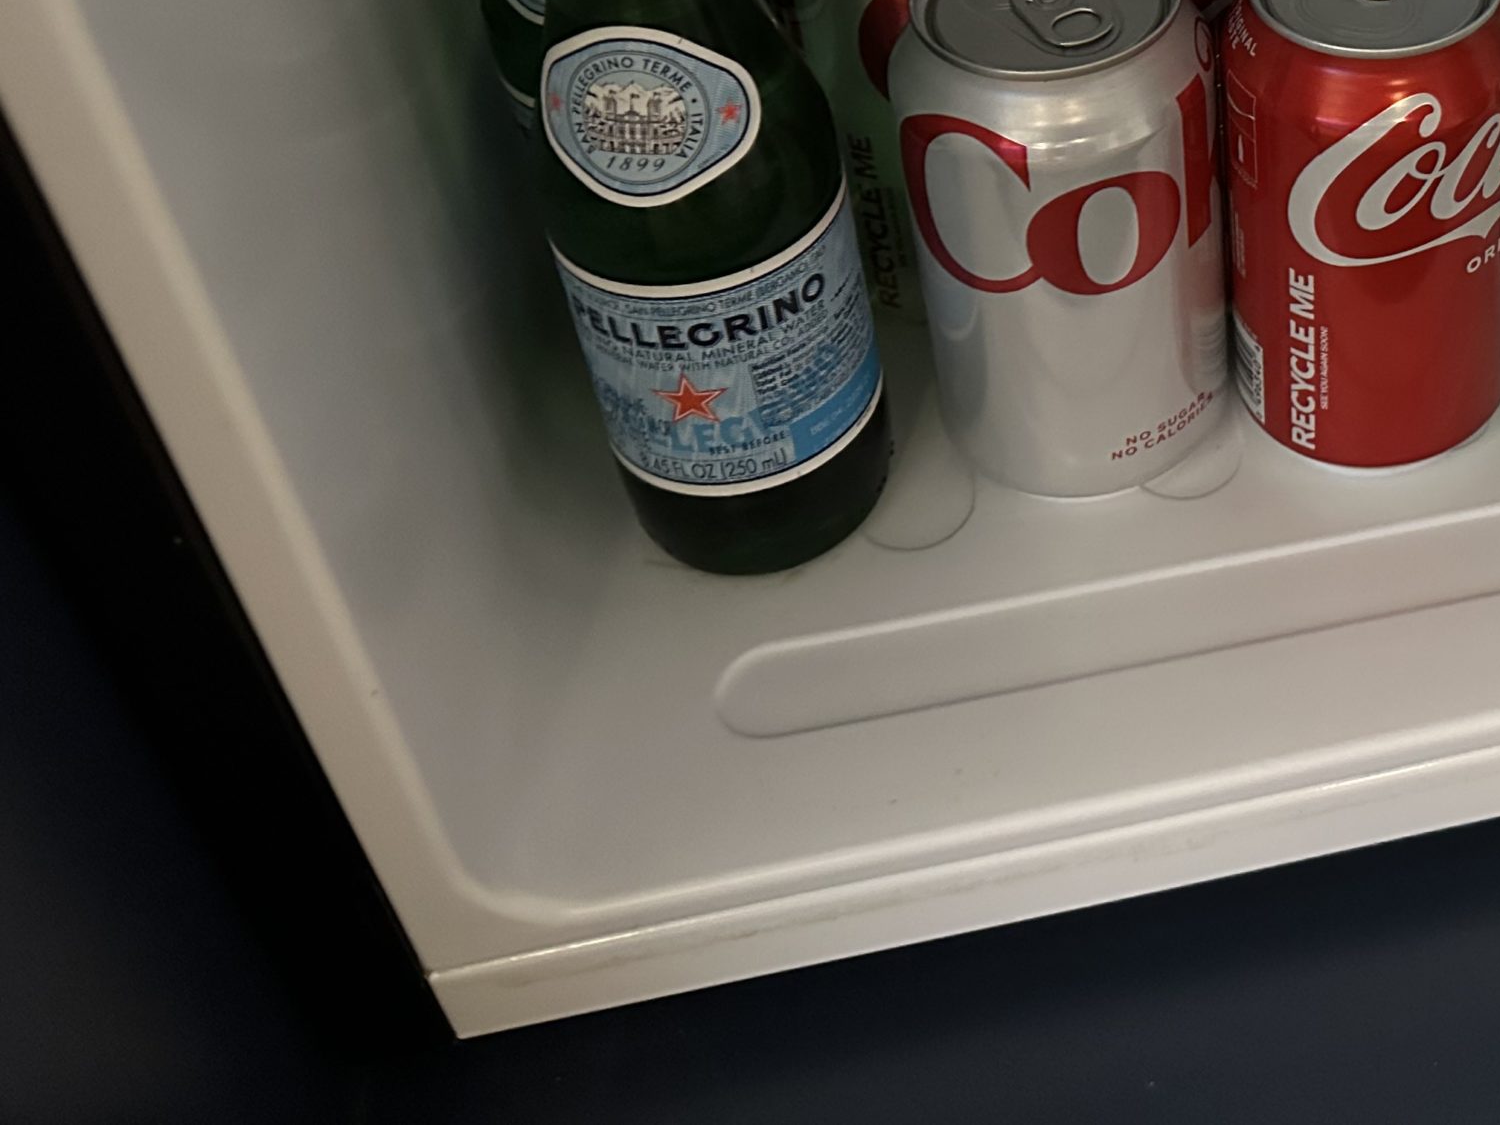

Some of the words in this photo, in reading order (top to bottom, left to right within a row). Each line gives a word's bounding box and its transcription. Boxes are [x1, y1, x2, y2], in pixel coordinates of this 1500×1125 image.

[571, 56, 634, 115] PELLEGRINO
[641, 58, 693, 93] TERME
[575, 125, 598, 155] SAN
[677, 112, 703, 159] ITALIA
[606, 156, 666, 173] 1899
[848, 133, 878, 180] ME
[860, 186, 902, 310] RECYCLE
[718, 292, 753, 310] TERME
[1288, 267, 1316, 320] ME
[622, 344, 695, 363] NATURAL
[701, 332, 773, 361] MINERAL
[780, 299, 826, 335] WATER
[715, 346, 772, 368] NATURAL
[1319, 352, 1328, 377] AGAIN
[1290, 319, 1316, 450] RECYCLE
[1319, 377, 1328, 394] YOU
[1319, 393, 1329, 410] SEE
[708, 443, 738, 456] BEST
[1126, 430, 1151, 446] NO
[1112, 446, 1138, 461] NO
[671, 459, 690, 474] FL
[691, 464, 715, 479] OZ
[720, 457, 757, 478] (250
